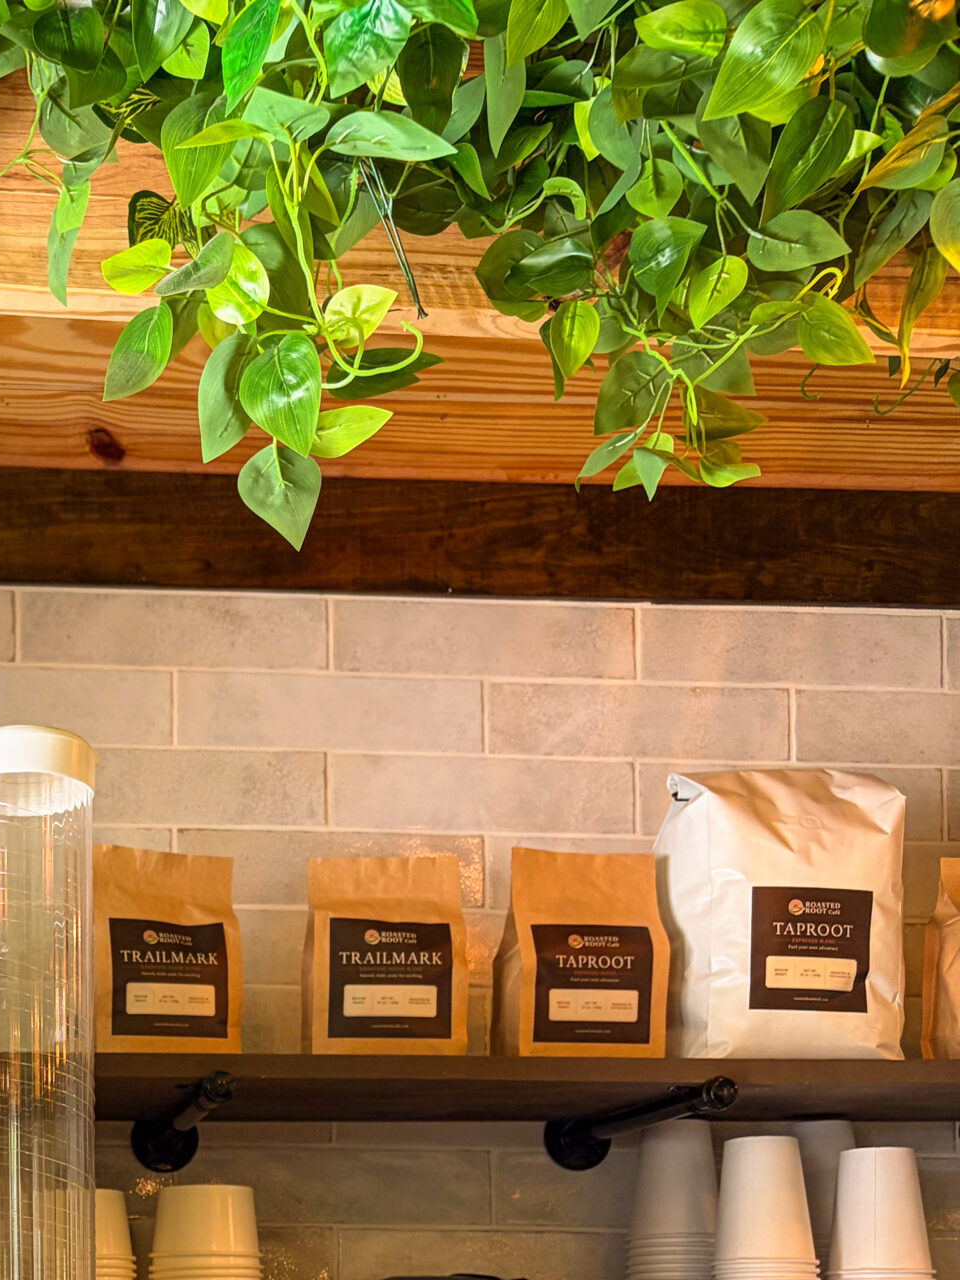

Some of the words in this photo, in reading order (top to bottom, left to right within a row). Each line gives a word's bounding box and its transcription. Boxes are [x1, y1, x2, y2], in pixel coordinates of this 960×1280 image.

[805, 901, 841, 909] ROASTED
[772, 922, 854, 938] TAPROOT
[120, 950, 219, 965] TRAILMARK
[338, 951, 443, 965] TRAILMARK
[555, 954, 635, 969] TAPROOT
